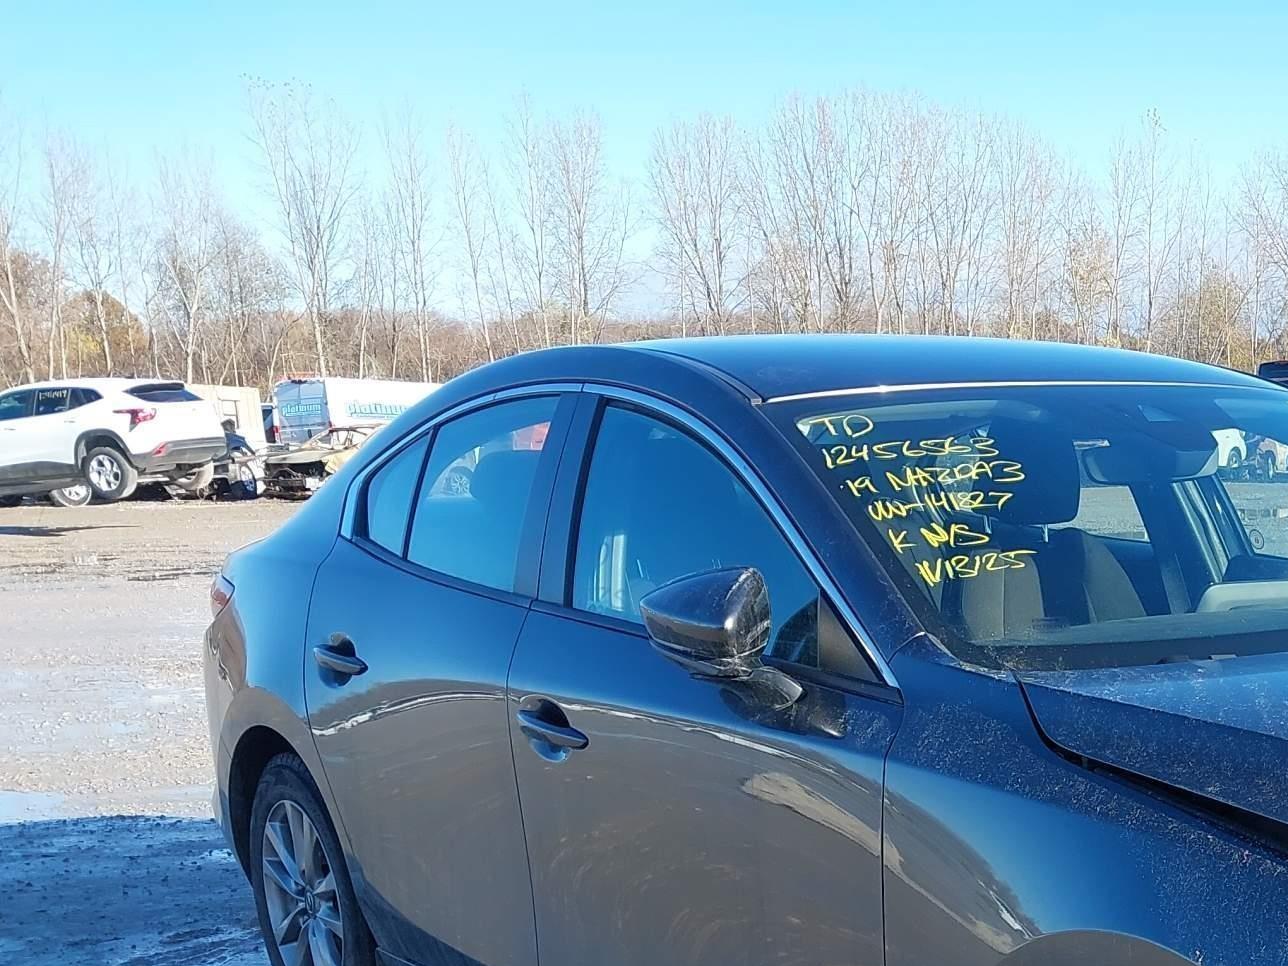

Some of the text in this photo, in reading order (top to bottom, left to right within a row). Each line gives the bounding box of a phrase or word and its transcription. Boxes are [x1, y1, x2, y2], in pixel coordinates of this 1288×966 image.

[282, 403, 321, 416] platinum
[346, 401, 408, 416] platinu
[809, 414, 874, 438] TD
[821, 436, 1000, 469] 12456563
[885, 460, 1026, 491] MAZDA3
[888, 528, 917, 554] K
